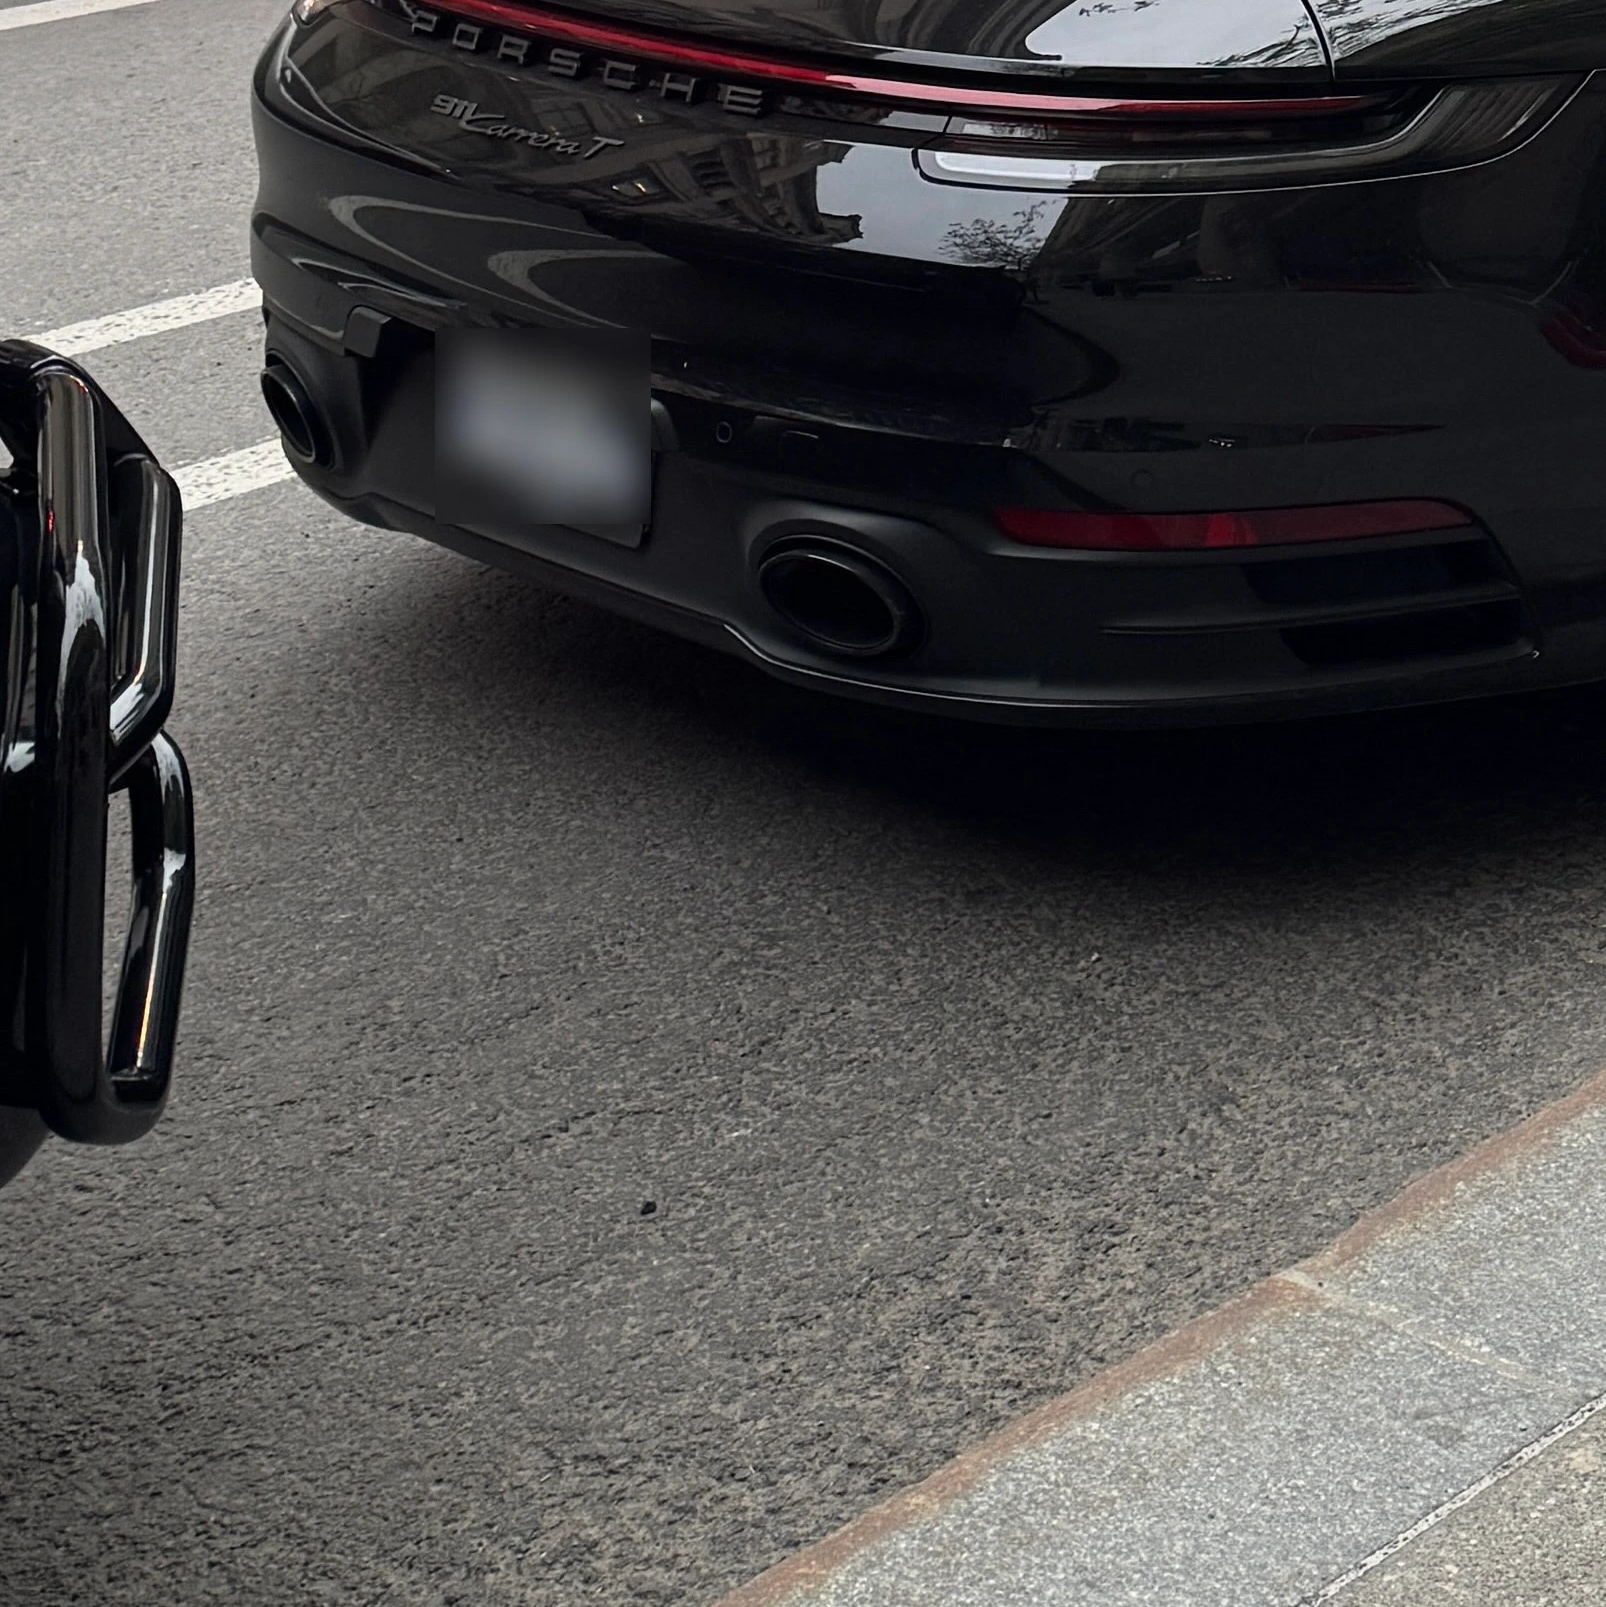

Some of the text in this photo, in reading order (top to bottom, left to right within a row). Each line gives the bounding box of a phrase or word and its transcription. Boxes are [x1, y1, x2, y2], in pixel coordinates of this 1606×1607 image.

[411, 9, 763, 115] PORSCHE
[459, 114, 581, 154] Carrera
[585, 136, 624, 159] T
